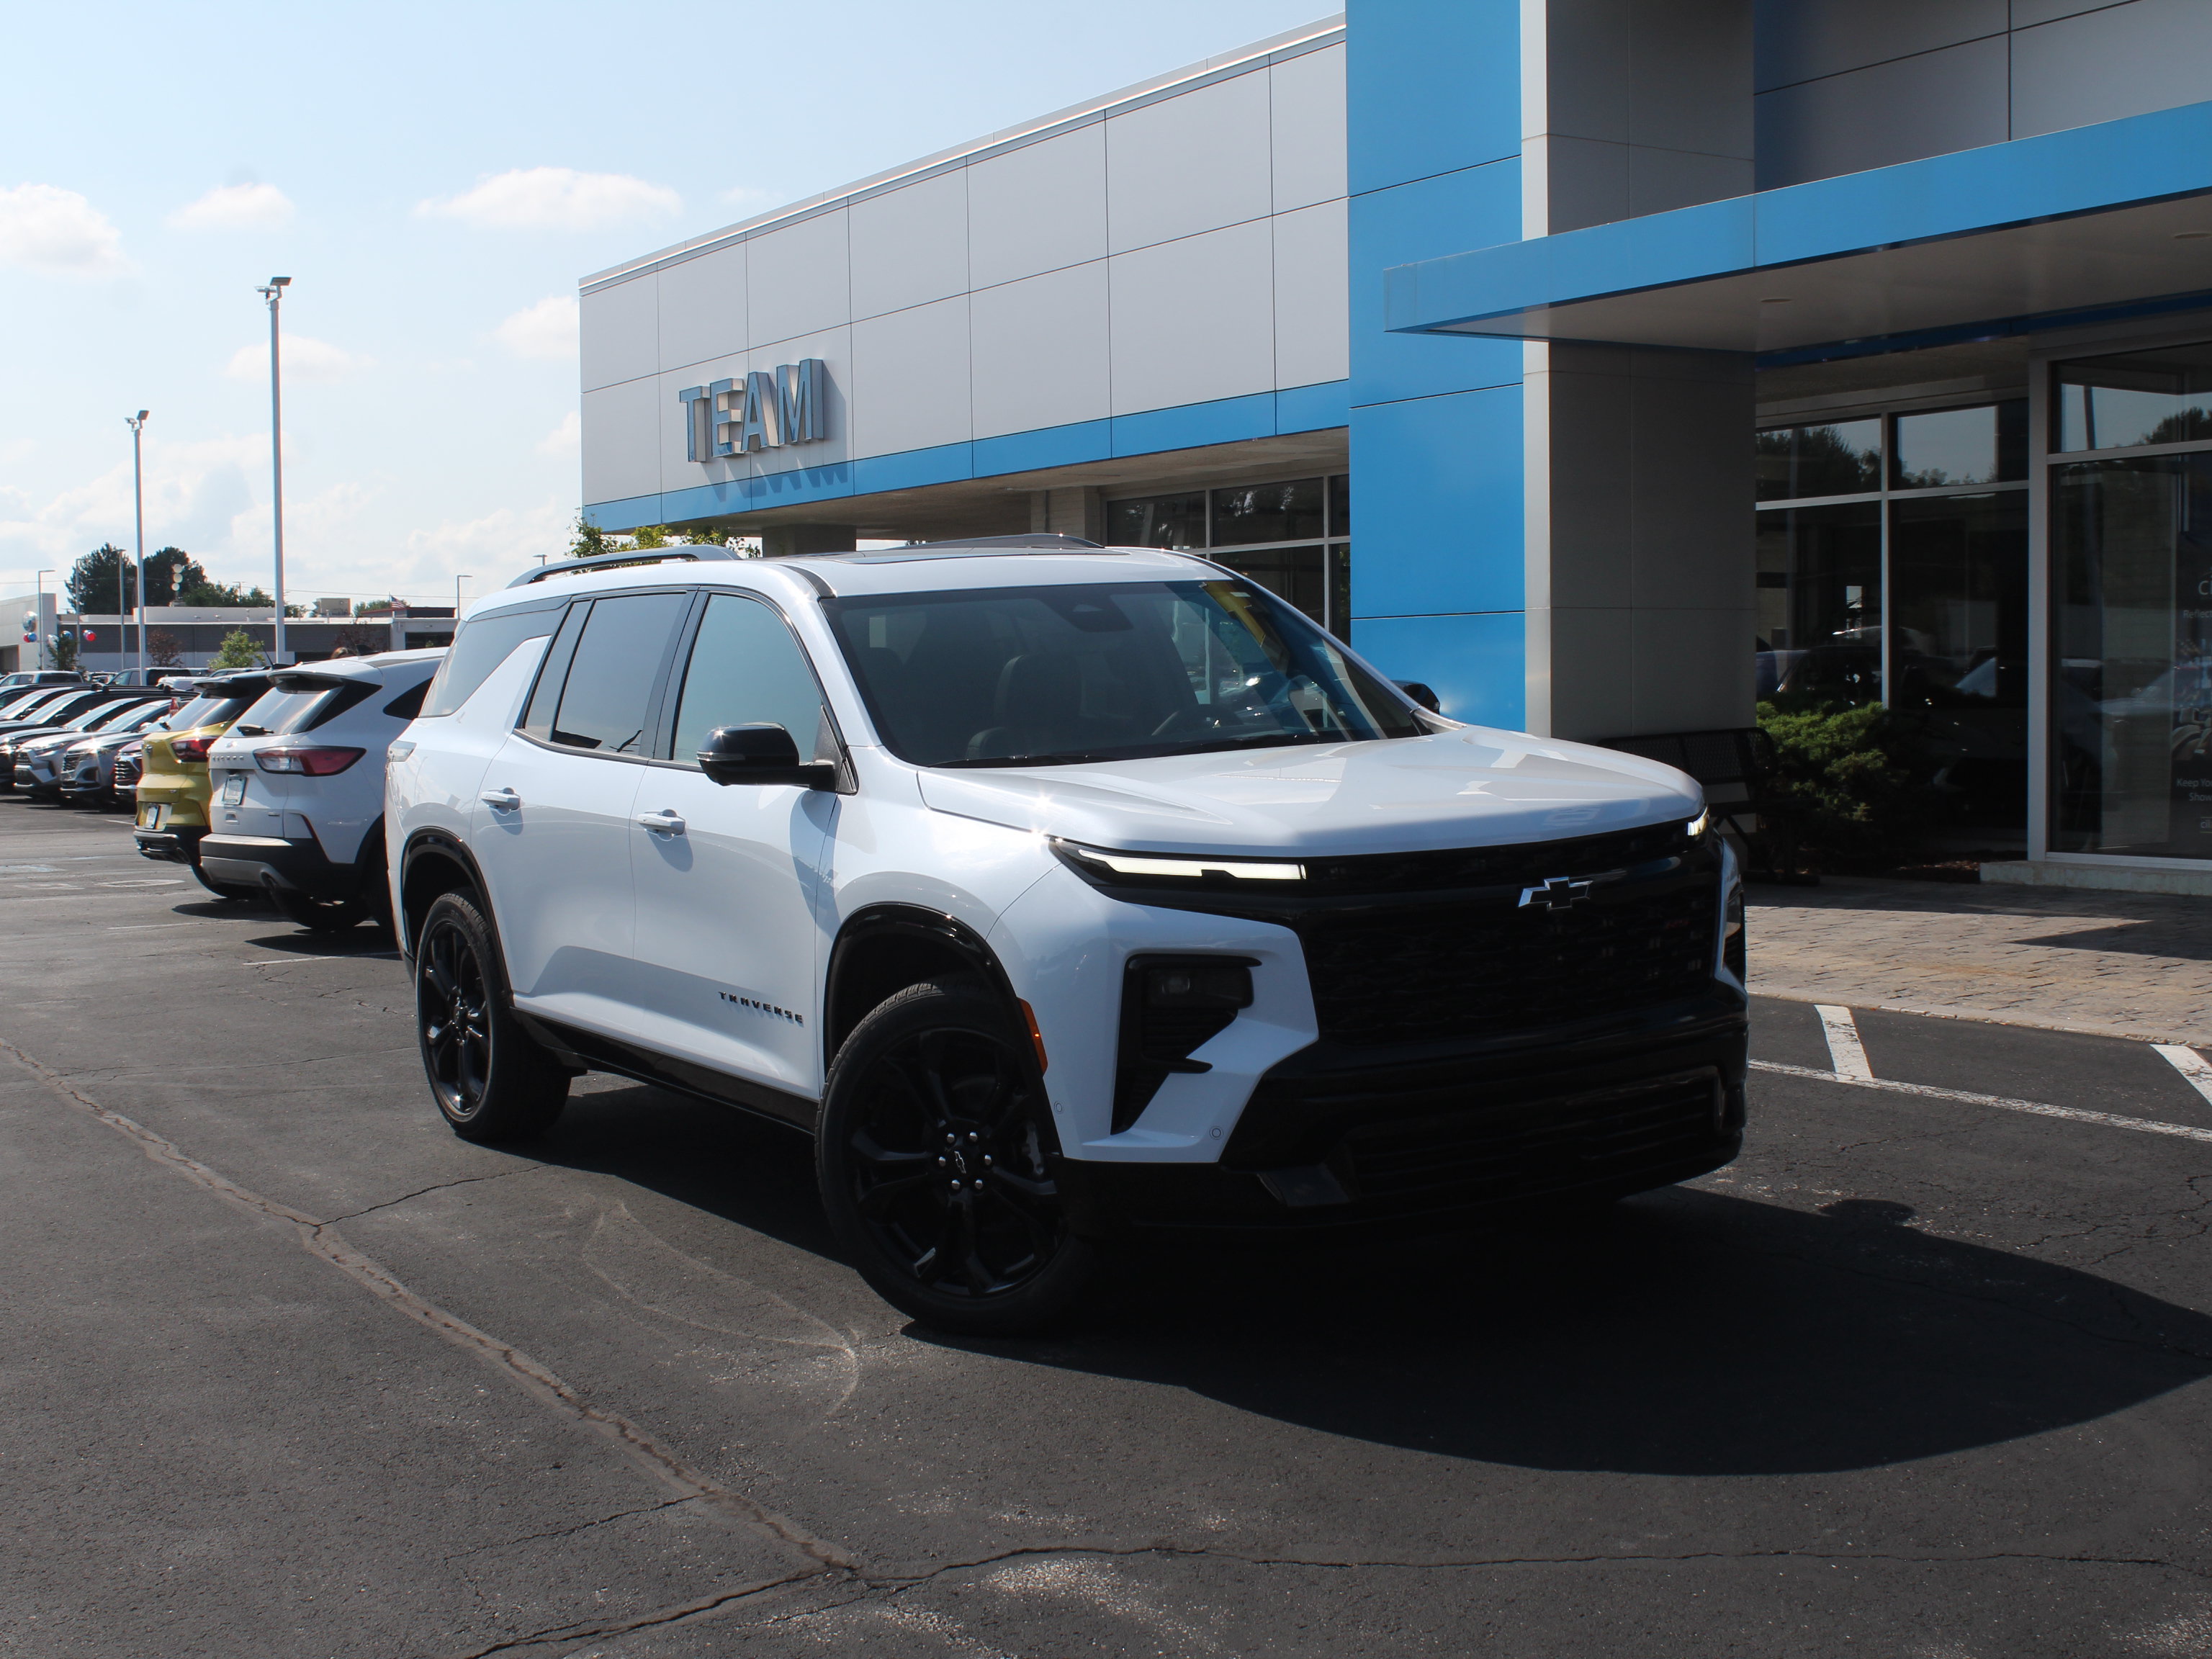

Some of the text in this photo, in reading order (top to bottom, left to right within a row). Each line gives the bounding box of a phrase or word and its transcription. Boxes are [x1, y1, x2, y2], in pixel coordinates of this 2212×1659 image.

[679, 359, 824, 462] TEAM
[2177, 778, 2200, 789] Keep
[718, 992, 804, 1024] TRAVERSE
